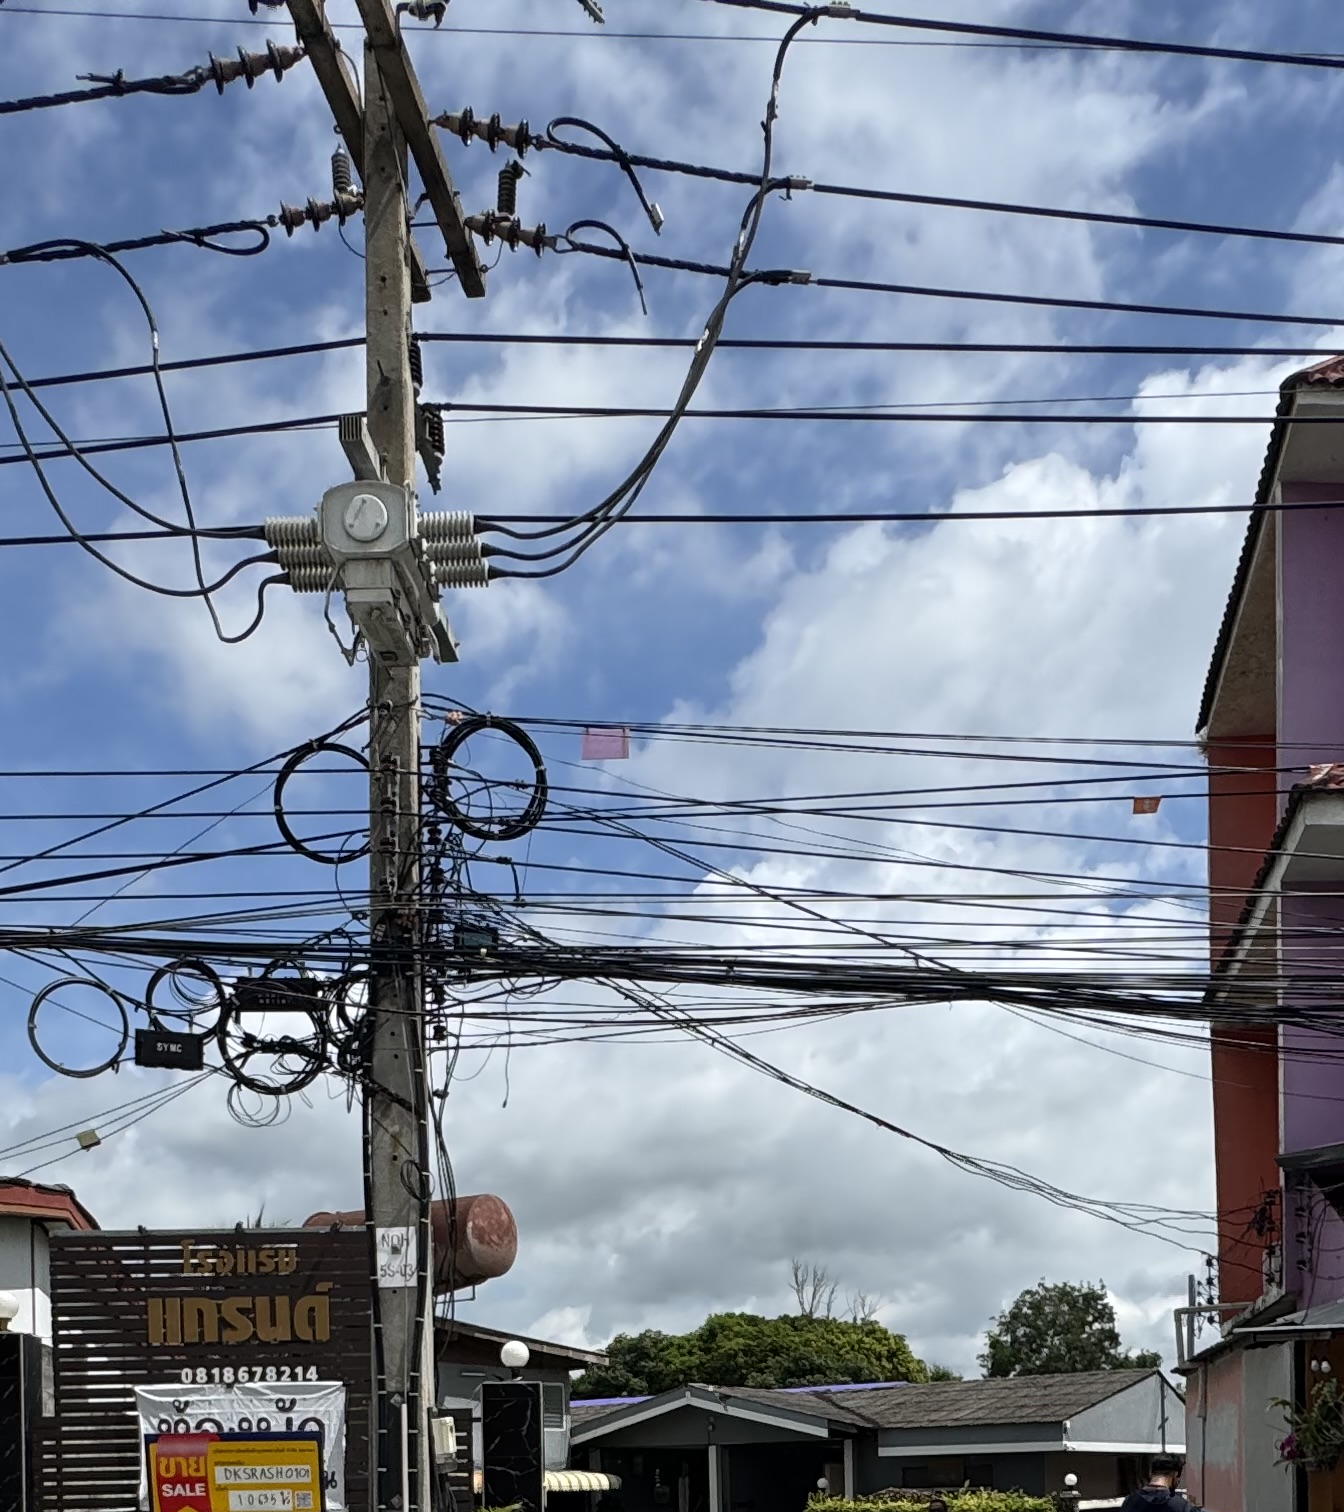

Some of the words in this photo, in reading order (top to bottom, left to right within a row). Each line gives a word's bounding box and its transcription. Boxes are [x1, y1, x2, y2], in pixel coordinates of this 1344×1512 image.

[147, 1281, 334, 1345] แกรนด์
[180, 1365, 319, 1384] 0818678214
[159, 1456, 206, 1478] ขาย
[161, 1482, 207, 1497] SALE
